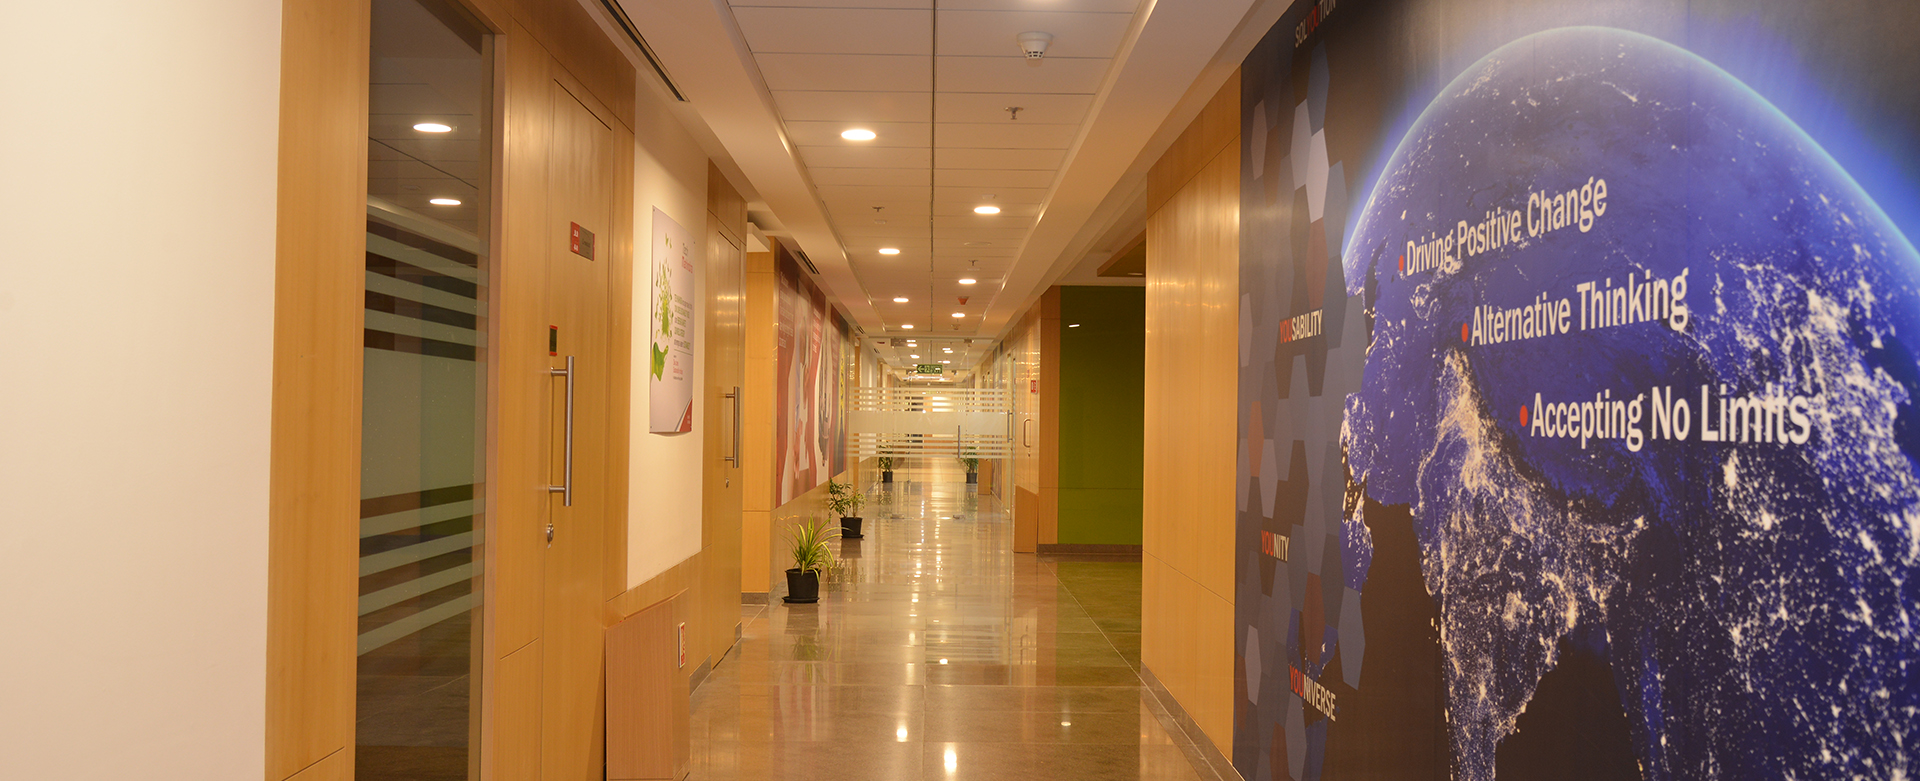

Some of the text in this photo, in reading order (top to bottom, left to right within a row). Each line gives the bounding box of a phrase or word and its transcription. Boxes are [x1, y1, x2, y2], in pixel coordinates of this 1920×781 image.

[1406, 176, 1607, 276] Driving Positive Change
[1279, 309, 1323, 344] YOUSABILITY
[1470, 267, 1689, 347] Alternative Thinking
[1530, 381, 1811, 453] Accepting No Limits
[1261, 529, 1289, 562] YOUNITY
[1289, 665, 1336, 722] YOUNIVERSE
